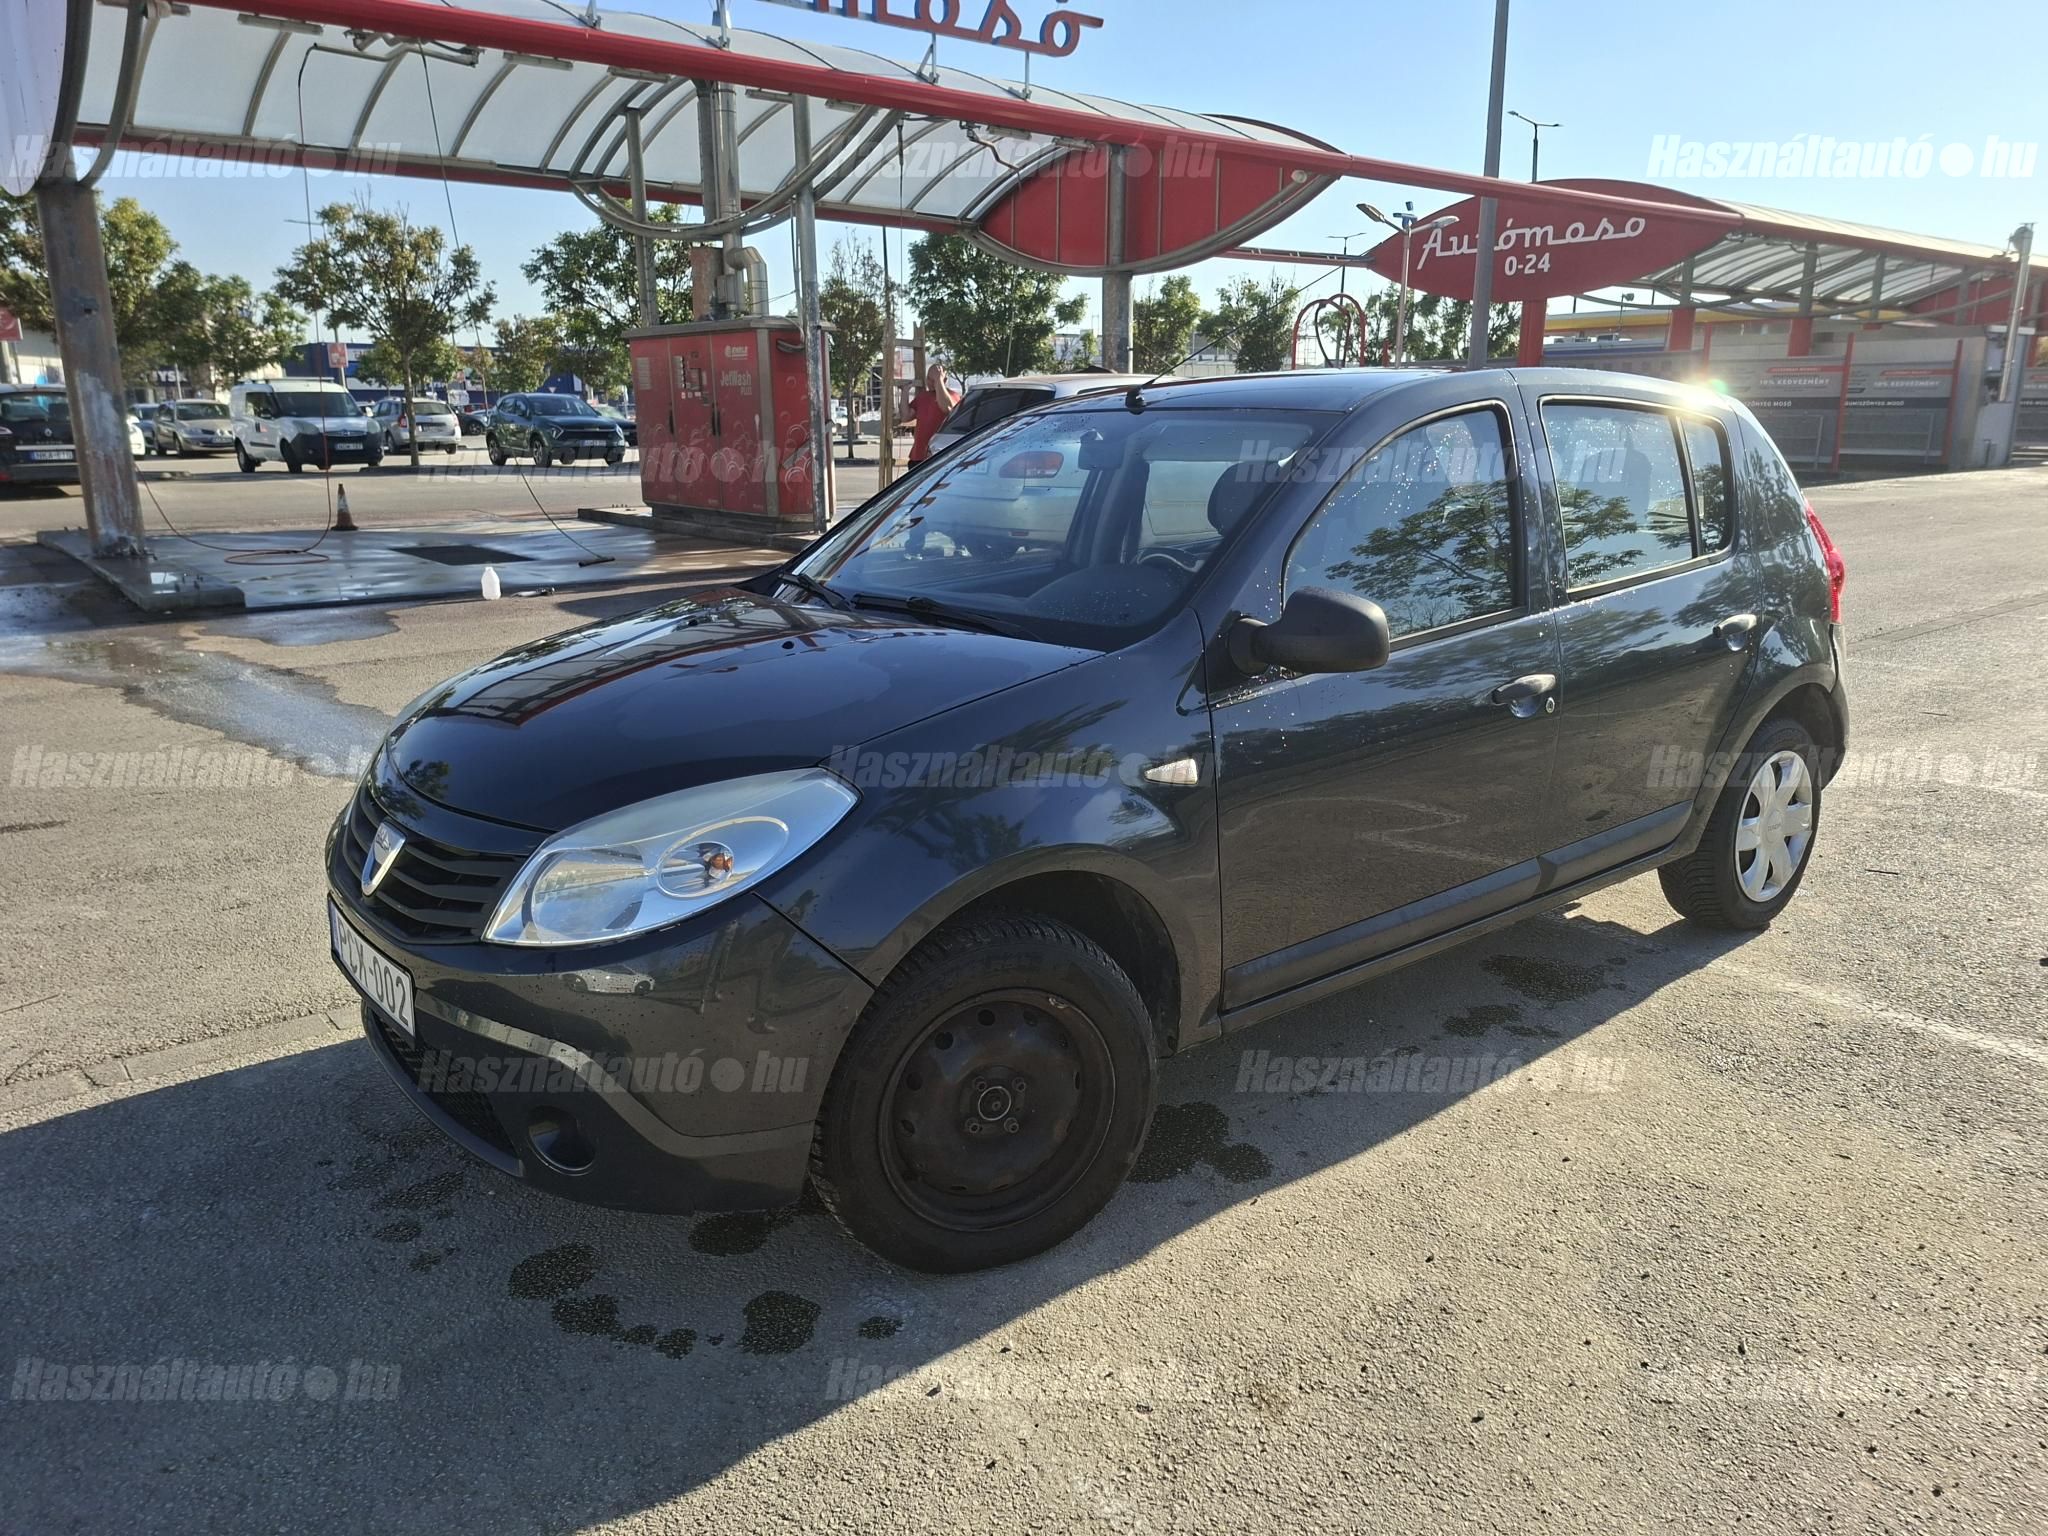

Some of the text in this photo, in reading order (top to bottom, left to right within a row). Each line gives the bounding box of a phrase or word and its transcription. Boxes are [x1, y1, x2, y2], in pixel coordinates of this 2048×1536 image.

[1417, 217, 1646, 270] Auómoso
[1504, 252, 1551, 276] 0-24
[719, 370, 752, 387] JetWash
[337, 916, 409, 1027] PCX-002
